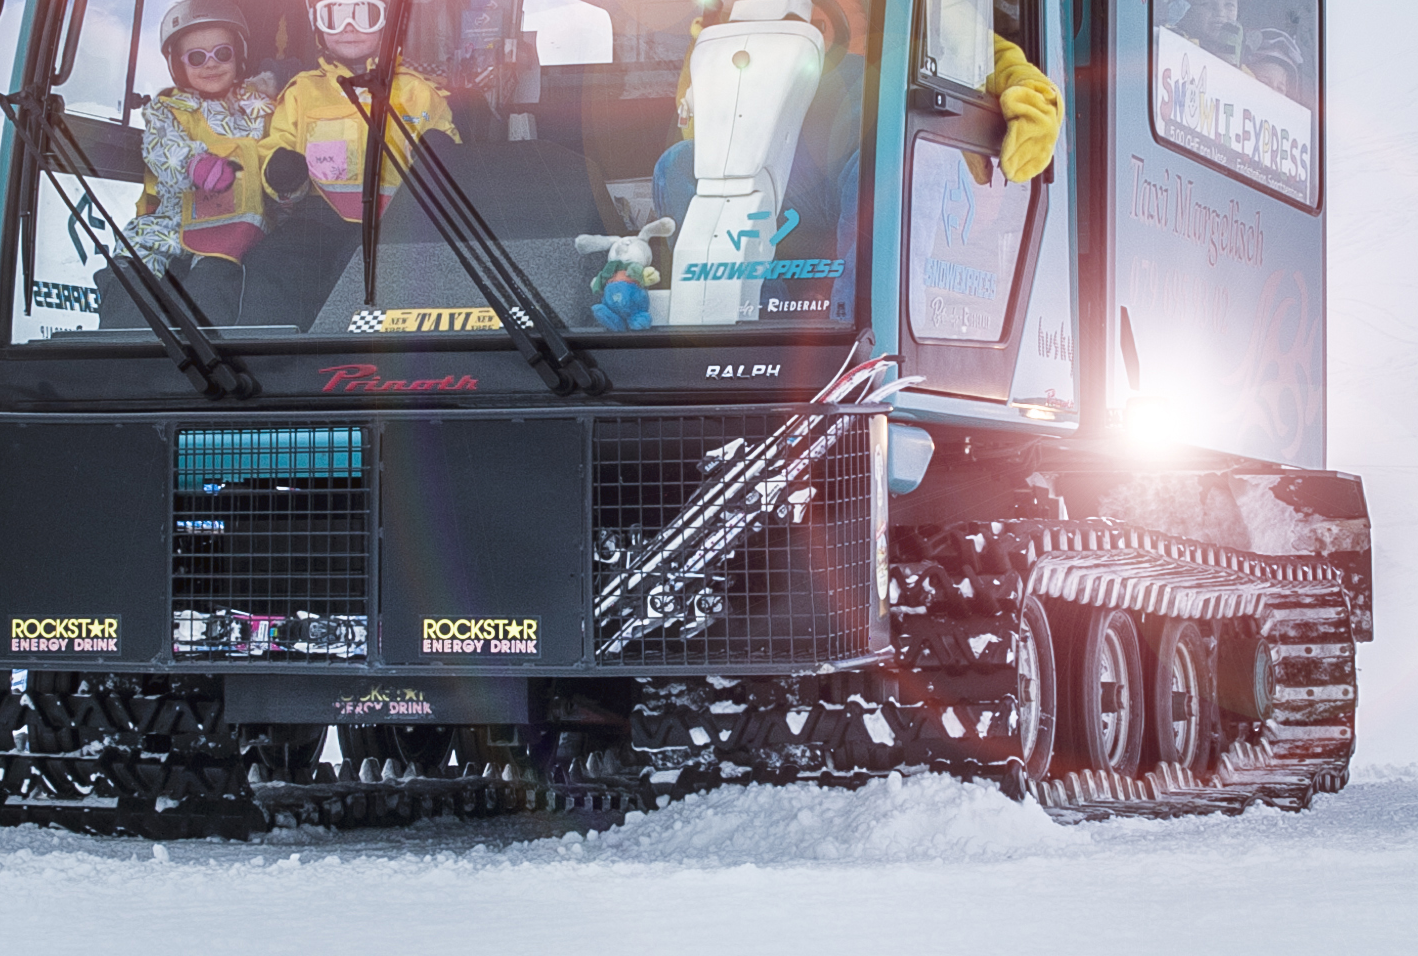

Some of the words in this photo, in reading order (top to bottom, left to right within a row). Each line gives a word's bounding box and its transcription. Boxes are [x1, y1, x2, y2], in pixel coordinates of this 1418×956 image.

[1130, 154, 1169, 231] Taxi
[680, 259, 846, 281] SNOWEXPRESS
[767, 297, 830, 313] RIEDERALP
[415, 311, 474, 332] TAXI
[319, 364, 479, 392] Prinoth
[705, 364, 781, 381] RALPH
[11, 638, 69, 652] ENERGY
[74, 638, 118, 652] DRINK
[422, 639, 484, 653] ENERGY
[490, 639, 538, 654] DRINK
[389, 701, 433, 714] DRINK
